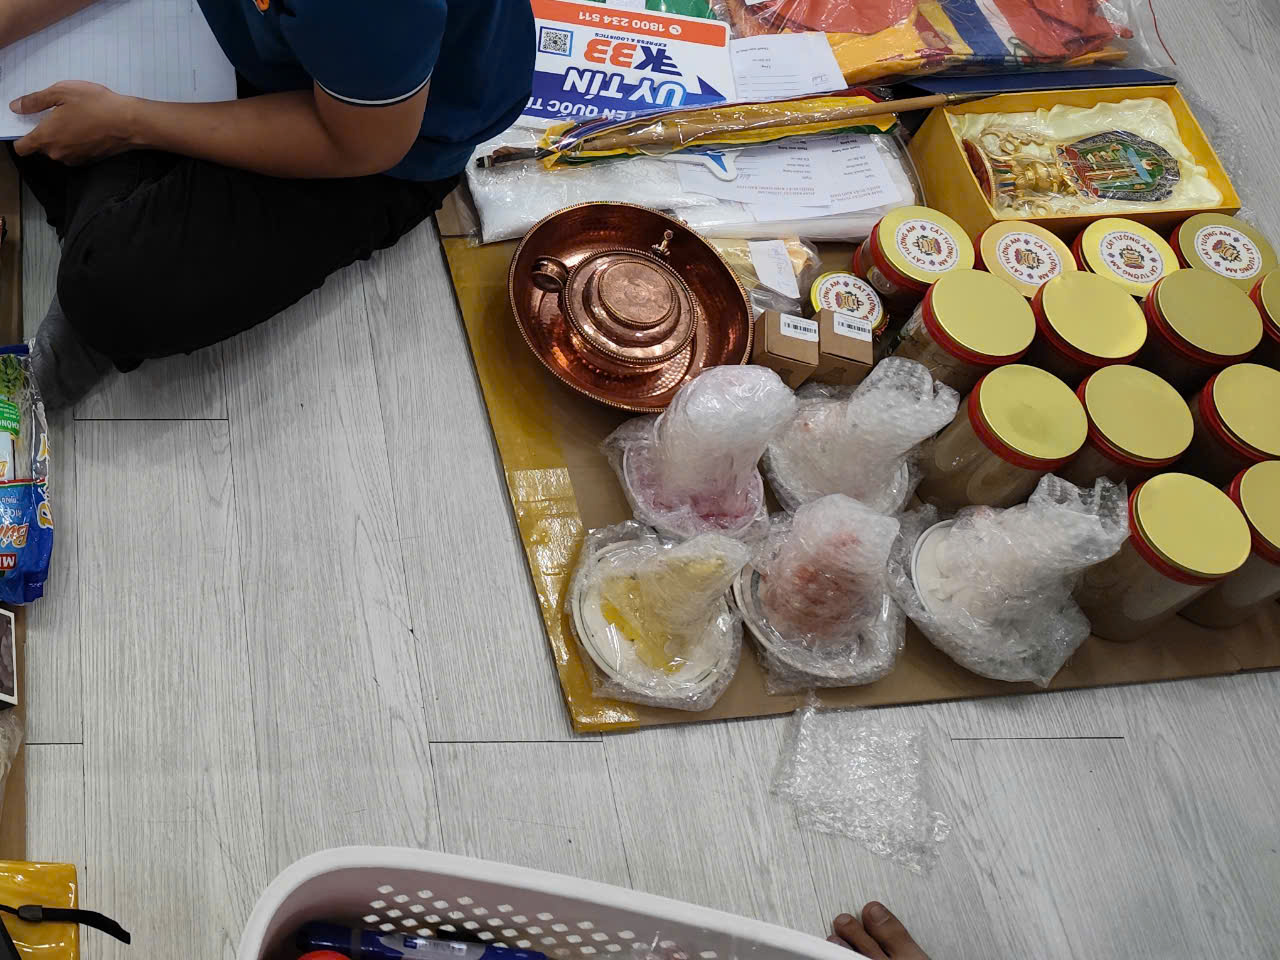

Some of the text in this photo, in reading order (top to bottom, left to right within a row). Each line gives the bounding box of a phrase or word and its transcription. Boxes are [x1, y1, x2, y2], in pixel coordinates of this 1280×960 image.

[578, 10, 666, 34] 1800 234 511
[594, 31, 629, 43] LOGISTICS
[635, 37, 667, 48] EXPRESS
[562, 67, 687, 108] UY TÍN
[547, 98, 598, 120] QUỐC
[905, 224, 918, 234] AM
[1218, 229, 1232, 238] AM
[929, 224, 943, 235] CÁT
[936, 257, 950, 269] AM
[1009, 236, 1022, 246] AM
[1033, 241, 1048, 252] CÁT
[1105, 238, 1116, 251] CÁT
[1141, 242, 1154, 255] AM
[911, 254, 927, 267] CÁT
[1109, 258, 1123, 270] AM
[1010, 266, 1025, 278] CÁT
[1224, 266, 1239, 275] AM
[828, 280, 841, 290] AM
[852, 282, 867, 294] CÁT
